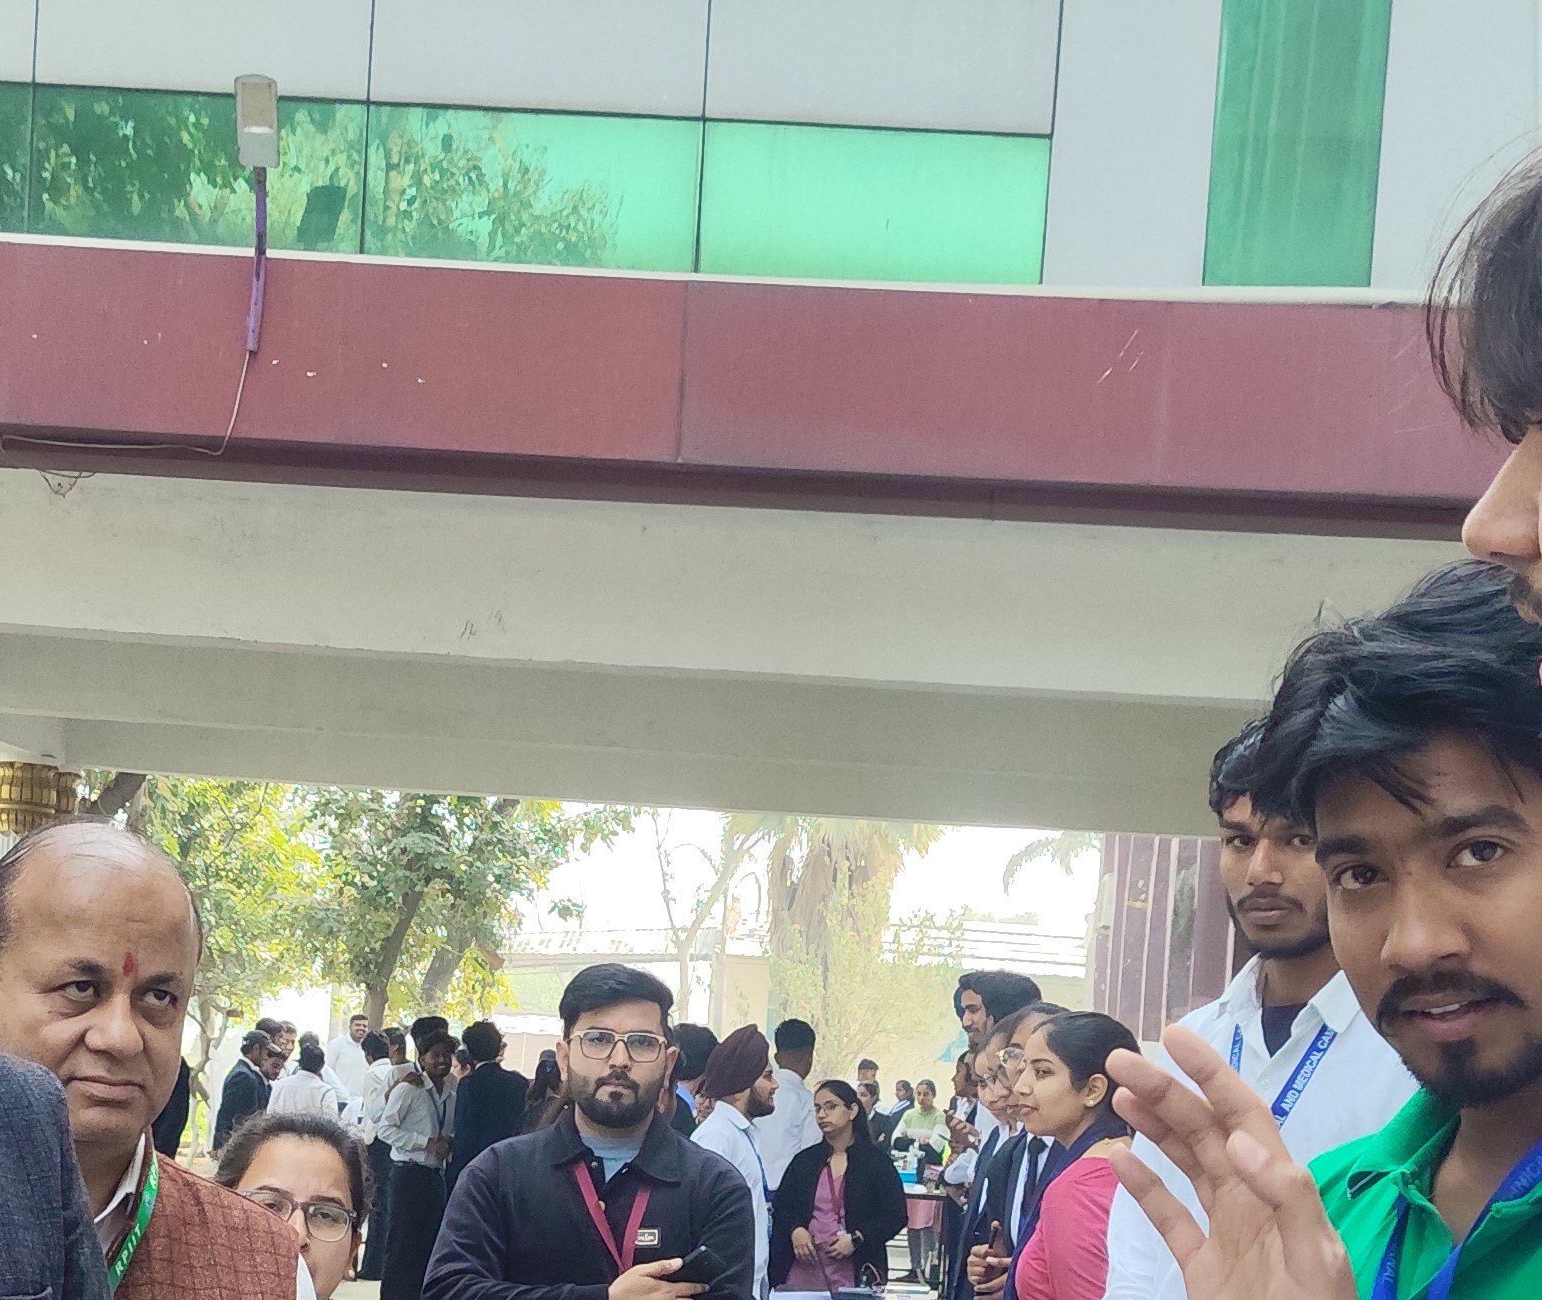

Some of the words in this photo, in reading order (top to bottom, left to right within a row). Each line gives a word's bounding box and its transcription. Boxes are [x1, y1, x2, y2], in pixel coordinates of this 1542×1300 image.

[1280, 1089, 1299, 1112] AND
[1292, 1050, 1324, 1092] MEDICAL
[114, 1222, 141, 1277] RPIIT
